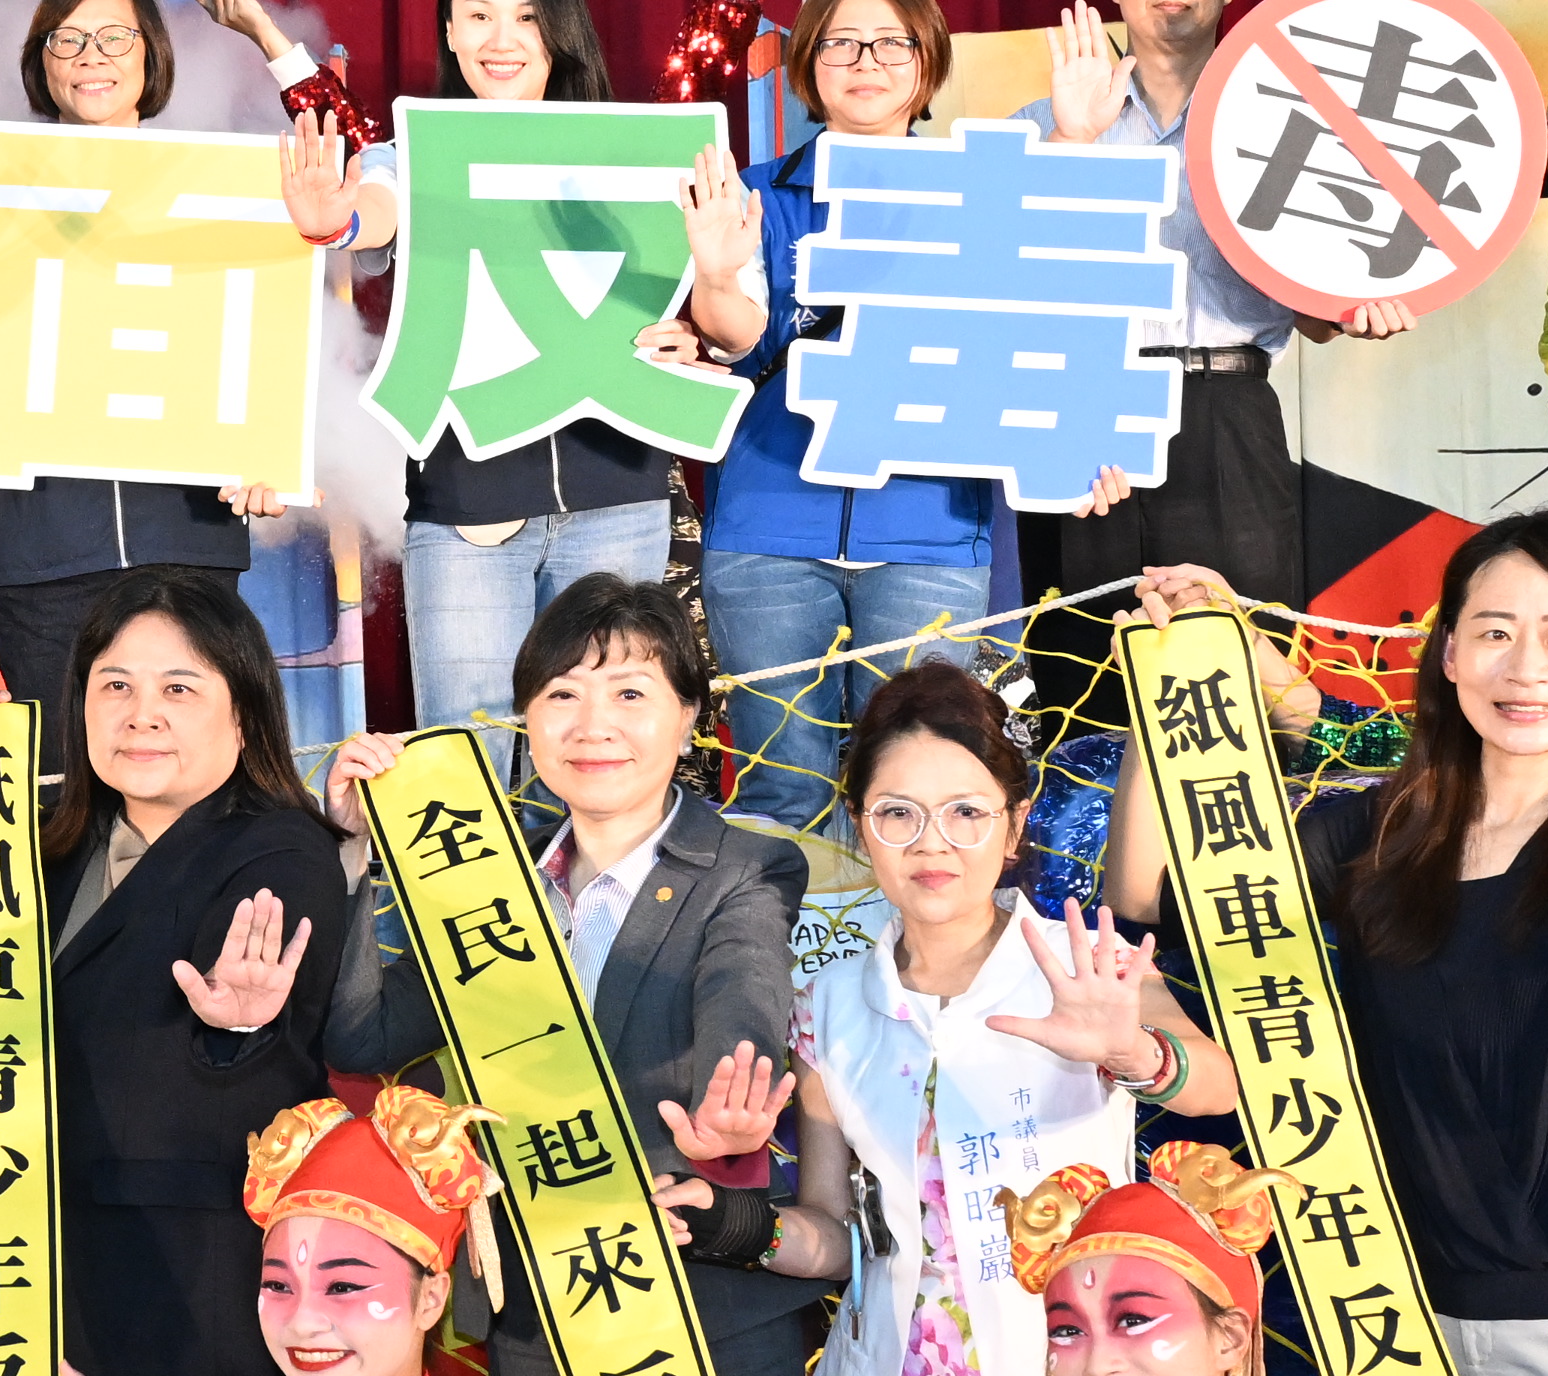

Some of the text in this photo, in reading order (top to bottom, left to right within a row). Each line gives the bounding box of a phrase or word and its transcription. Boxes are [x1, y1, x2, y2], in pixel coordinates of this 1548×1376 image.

[1235, 18, 1497, 280] 毒
[1009, 1088, 1041, 1173] 市議員
